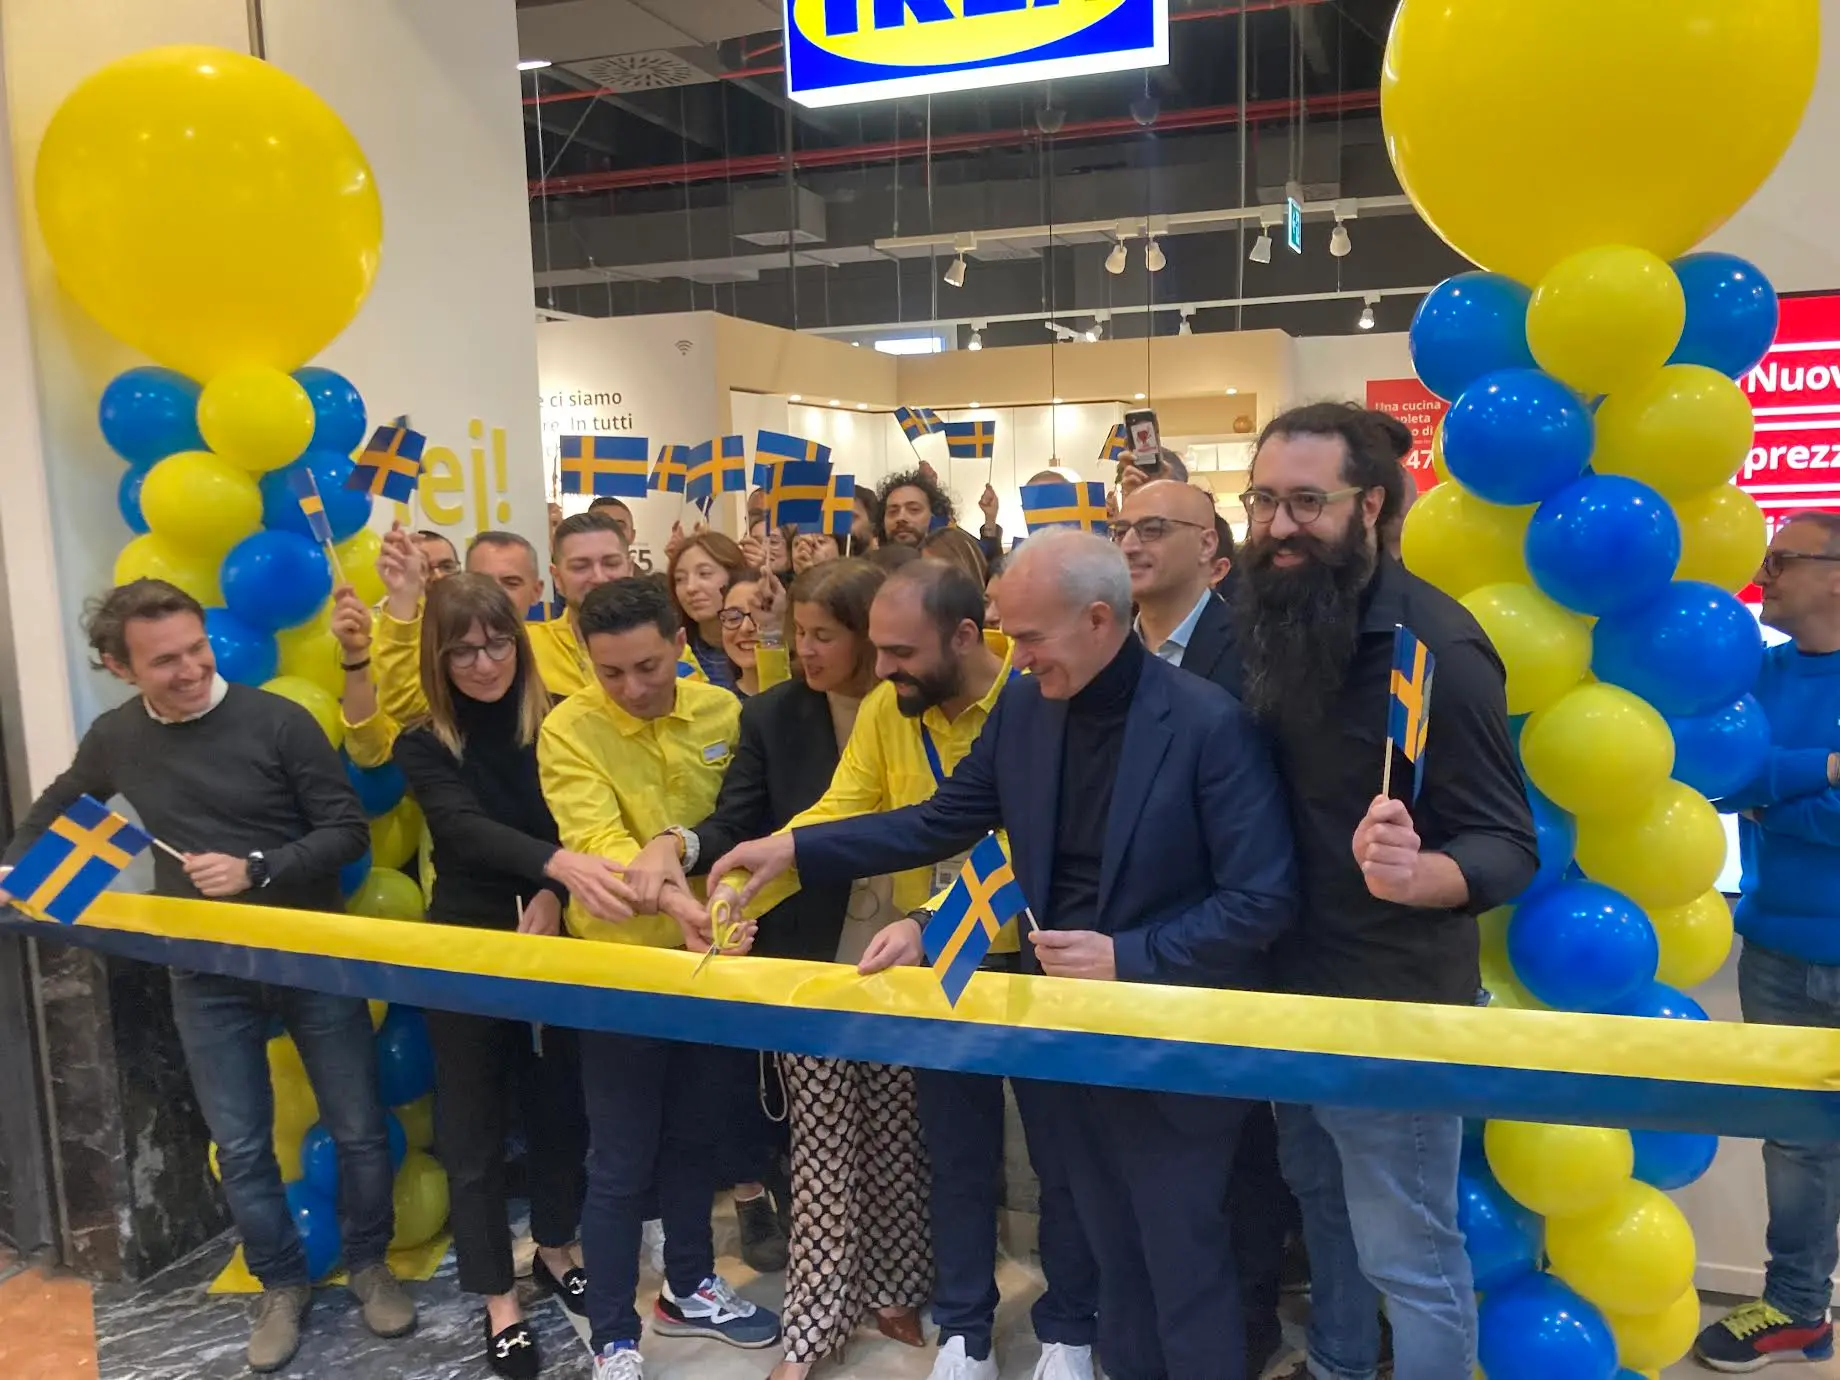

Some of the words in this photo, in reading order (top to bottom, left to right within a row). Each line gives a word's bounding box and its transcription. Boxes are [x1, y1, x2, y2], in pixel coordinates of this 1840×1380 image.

[550, 391, 563, 407] ci
[569, 390, 622, 406] siamo
[1375, 402, 1399, 412] Una
[1402, 400, 1441, 411] cucina
[593, 413, 632, 431] tutti
[1422, 425, 1433, 436] di
[349, 419, 511, 547] ej!
